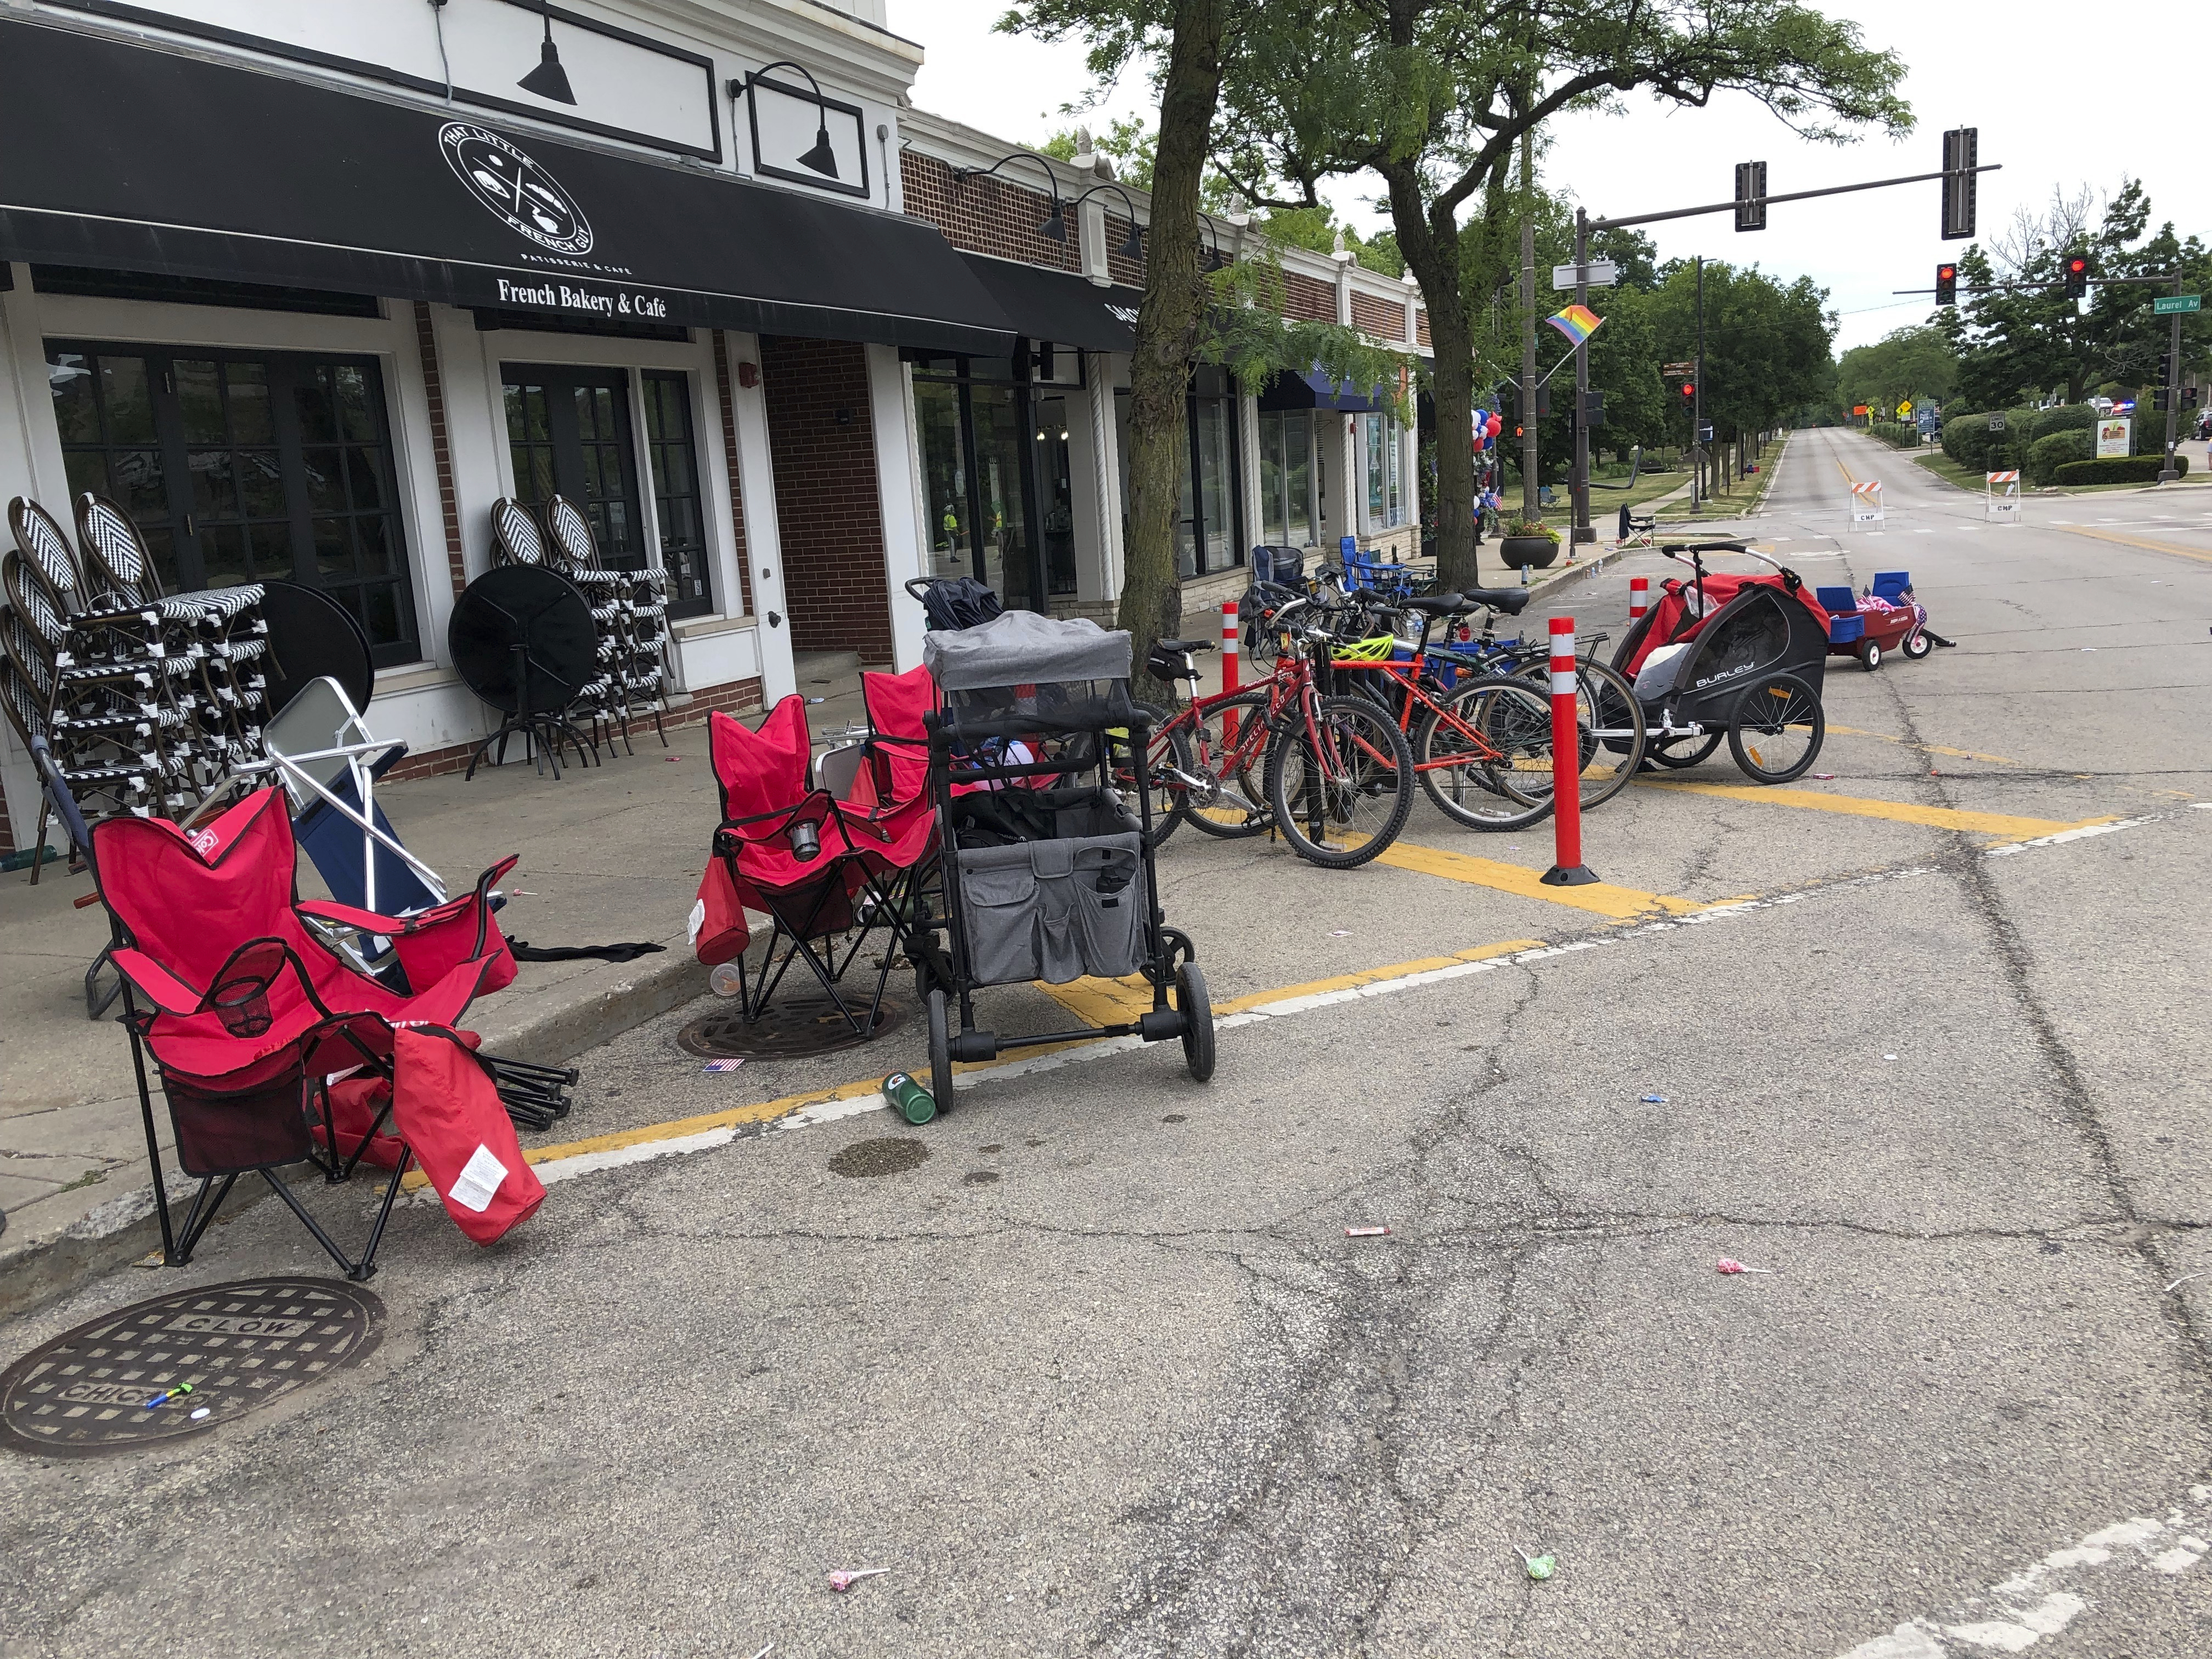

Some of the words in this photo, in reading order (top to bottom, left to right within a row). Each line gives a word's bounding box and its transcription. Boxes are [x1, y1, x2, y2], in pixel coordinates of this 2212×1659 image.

[444, 126, 470, 146] THAT
[472, 128, 534, 167] LITTLE
[507, 216, 577, 252] FRENCH
[575, 225, 589, 249] GUY
[521, 253, 590, 269] PATISSERIE
[496, 279, 556, 306] French
[558, 285, 613, 317] Bakery
[618, 294, 631, 313] &
[634, 295, 667, 318] Café
[2157, 301, 2182, 310] Laurel
[2188, 300, 2198, 308] Av
[1696, 661, 1754, 687] BURLEY
[186, 1318, 295, 1333] CLOW
